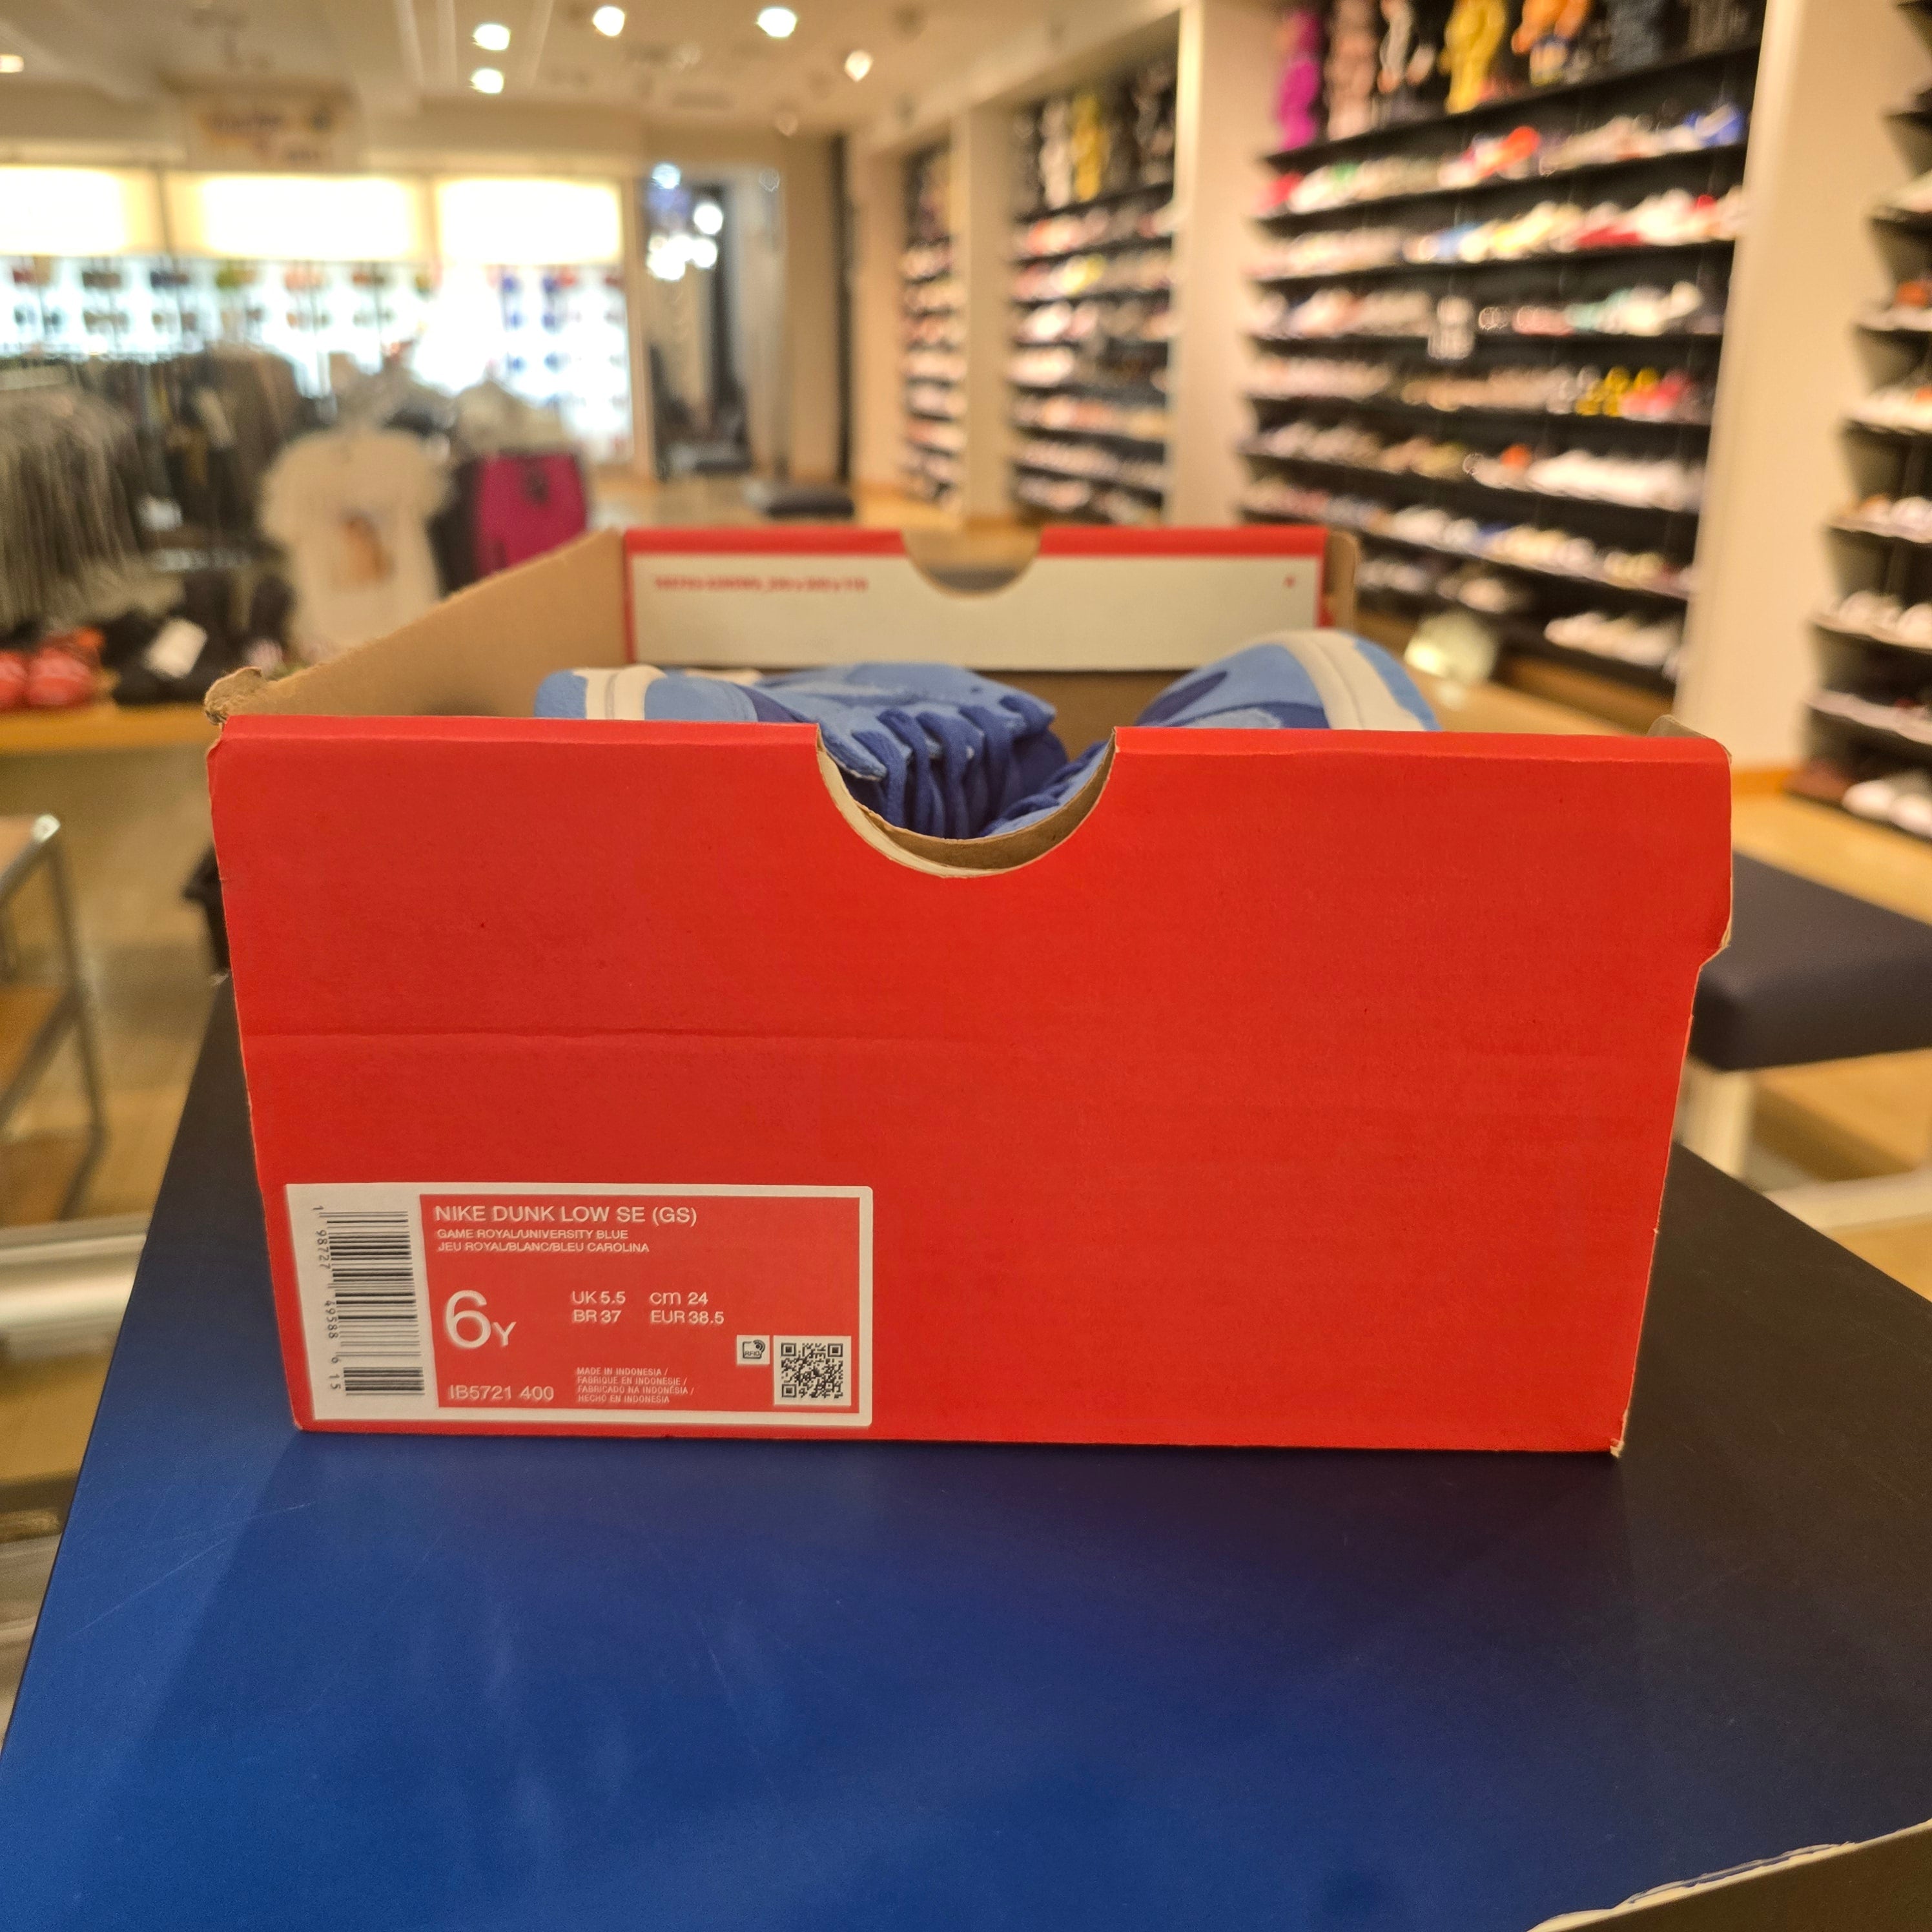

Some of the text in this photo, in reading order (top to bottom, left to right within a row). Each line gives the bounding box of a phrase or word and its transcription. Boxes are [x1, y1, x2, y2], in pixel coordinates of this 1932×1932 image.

[435, 1206, 697, 1227] NIKE DUNK LOW SE (GS)
[437, 1229, 628, 1239] GAME ROYAL/UNIVERSITY BLUE
[438, 1242, 650, 1253] JEU ROYAL/BLANC/BLEU CAROLINA
[316, 1230, 331, 1269] 98727
[324, 1300, 339, 1339] 49588
[572, 1291, 626, 1304] UK 5.5
[650, 1292, 708, 1306] cm 24
[573, 1310, 622, 1323] BR 37
[650, 1311, 724, 1324] EUR 38.5
[615, 1368, 662, 1376] INDONESIA
[577, 1376, 618, 1385] FABRIQUE
[621, 1377, 633, 1385] EN
[449, 1385, 555, 1401] IB5721 400
[577, 1385, 625, 1394] FABRICADO
[578, 1395, 670, 1403] HECHO EN INDONESIA
